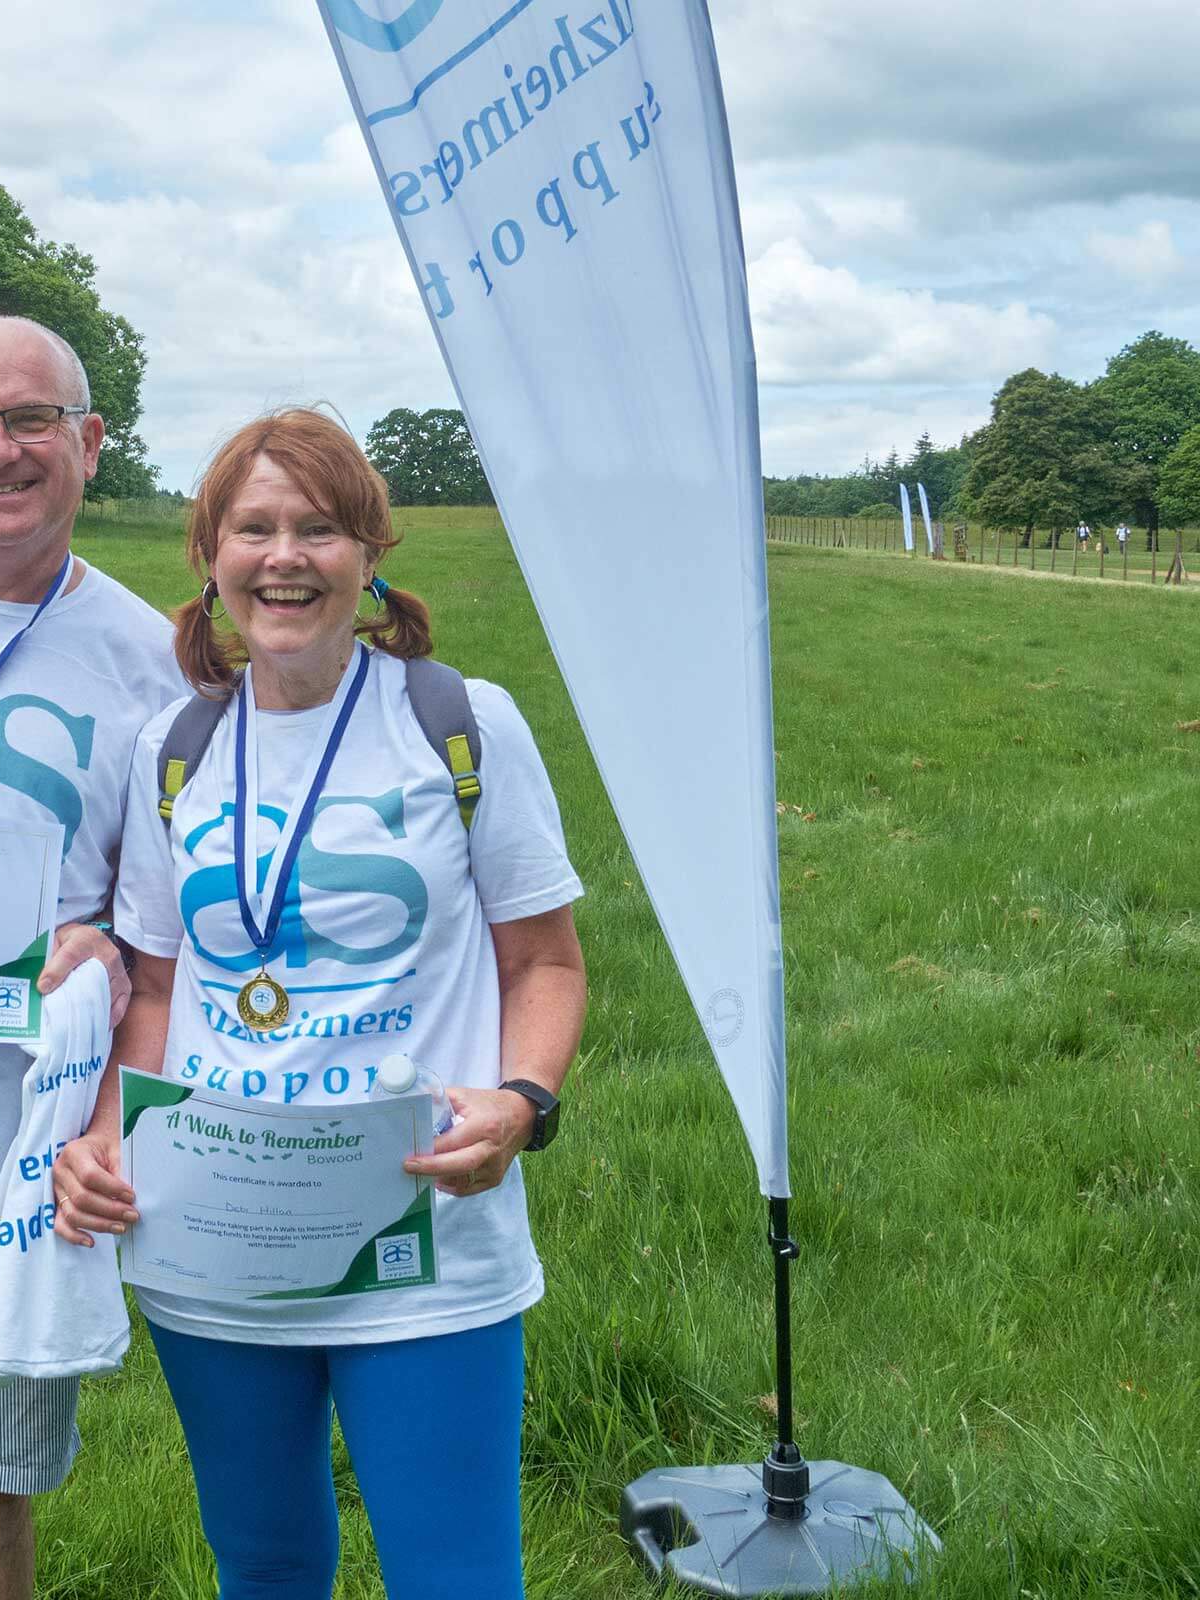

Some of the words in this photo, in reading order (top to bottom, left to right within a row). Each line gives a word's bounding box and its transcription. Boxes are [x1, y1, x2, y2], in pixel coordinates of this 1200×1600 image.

[180, 1054, 379, 1103] suppor
[166, 1111, 180, 1129] A
[184, 1114, 235, 1142] Walk
[239, 1128, 257, 1145] to
[261, 1129, 365, 1150] Remember
[307, 1152, 362, 1165] Bowood
[212, 1171, 227, 1181] This
[229, 1175, 267, 1186] certificate
[268, 1179, 275, 1187] is
[277, 1180, 312, 1188] awarded
[313, 1180, 322, 1188] to
